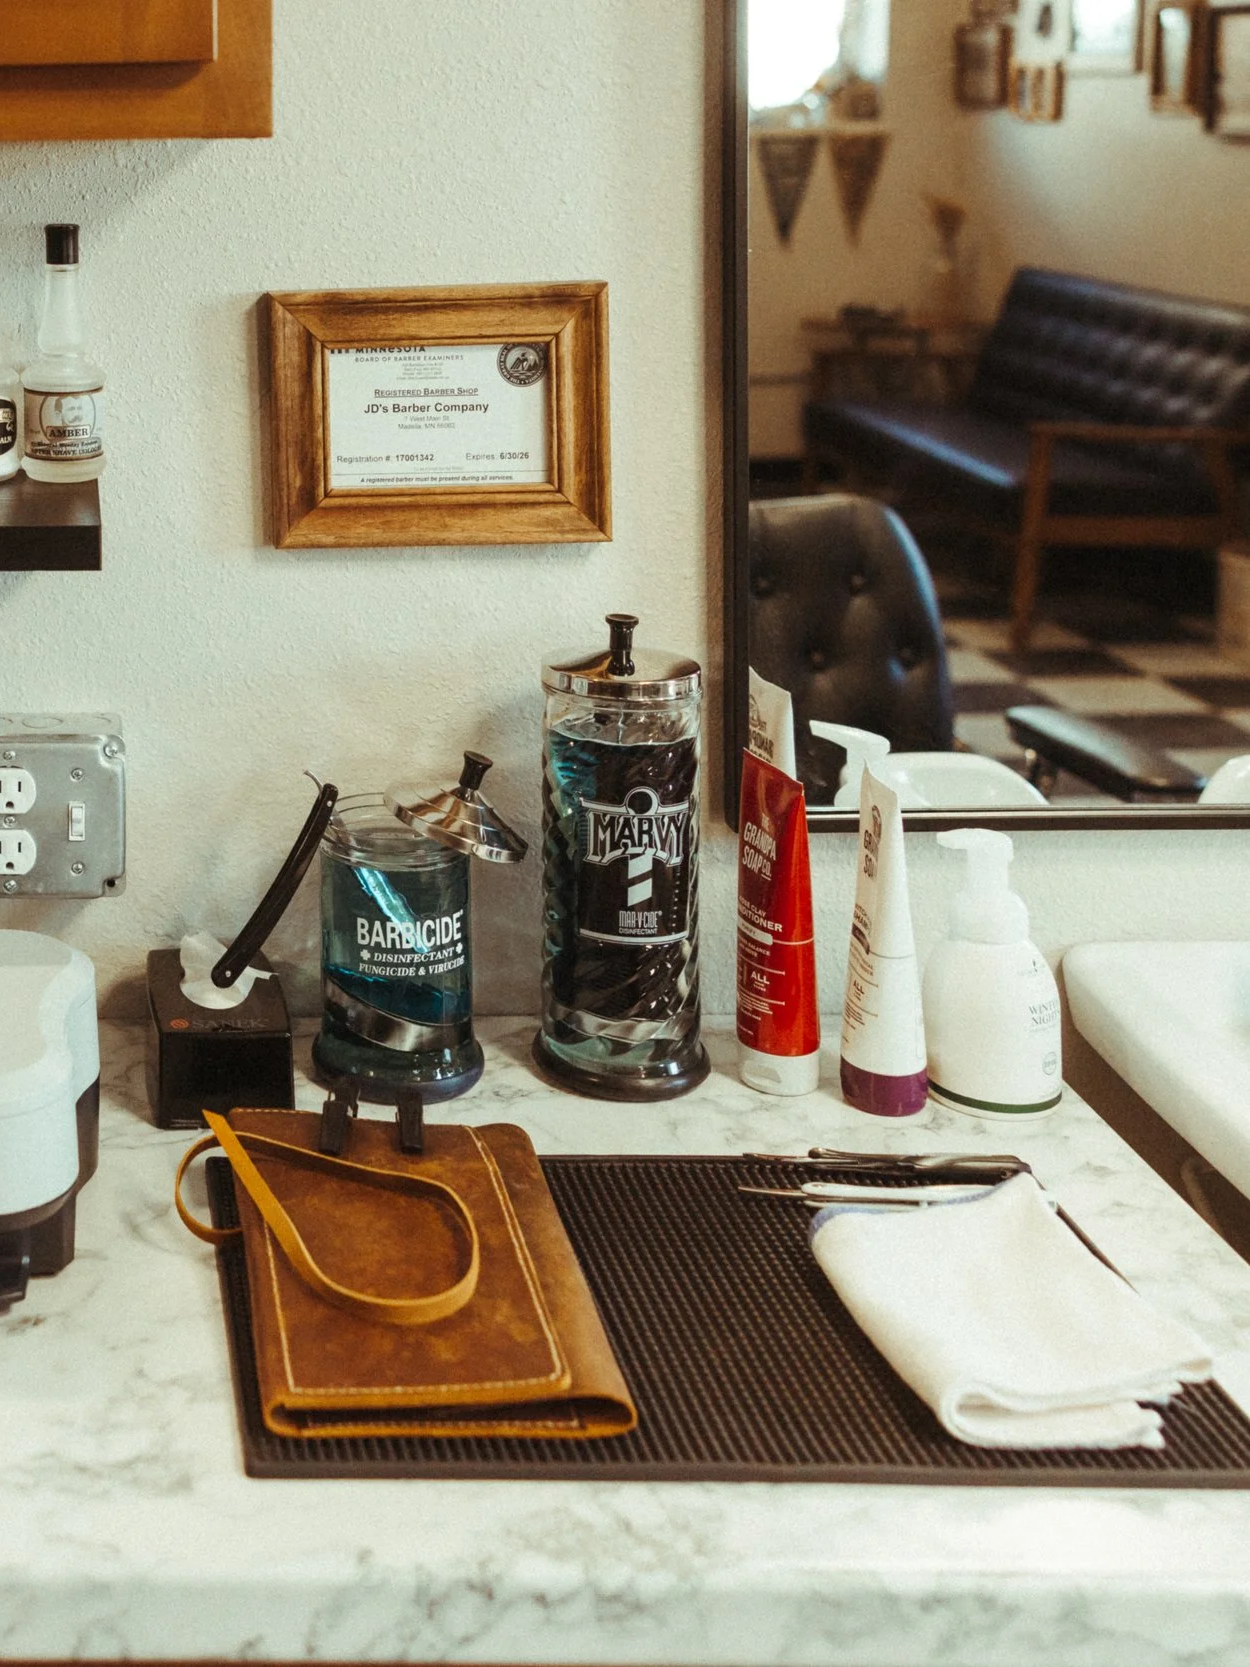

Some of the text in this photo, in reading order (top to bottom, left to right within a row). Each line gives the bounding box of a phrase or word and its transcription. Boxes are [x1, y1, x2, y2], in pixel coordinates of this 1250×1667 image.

[374, 387, 478, 397] REGISTERED BARBER SHOP
[364, 402, 489, 414] JD's Barber Company
[49, 427, 89, 438] AMBER
[336, 454, 384, 464] Registration
[396, 453, 435, 462] 17001342
[499, 452, 530, 461] 6/30/26
[461, 475, 478, 483] during
[588, 811, 688, 866] MARVY
[743, 822, 776, 860] GRANDPA
[742, 845, 772, 877] SOAP CO.
[356, 910, 462, 950] BARBICIDE
[618, 927, 658, 935] DISINFECTANT
[373, 946, 455, 963] DISINFECTANT
[358, 955, 465, 977] FUNGICIDE & VIRUCIDE
[751, 970, 770, 985] ALL
[191, 1018, 267, 1030] SANEK
